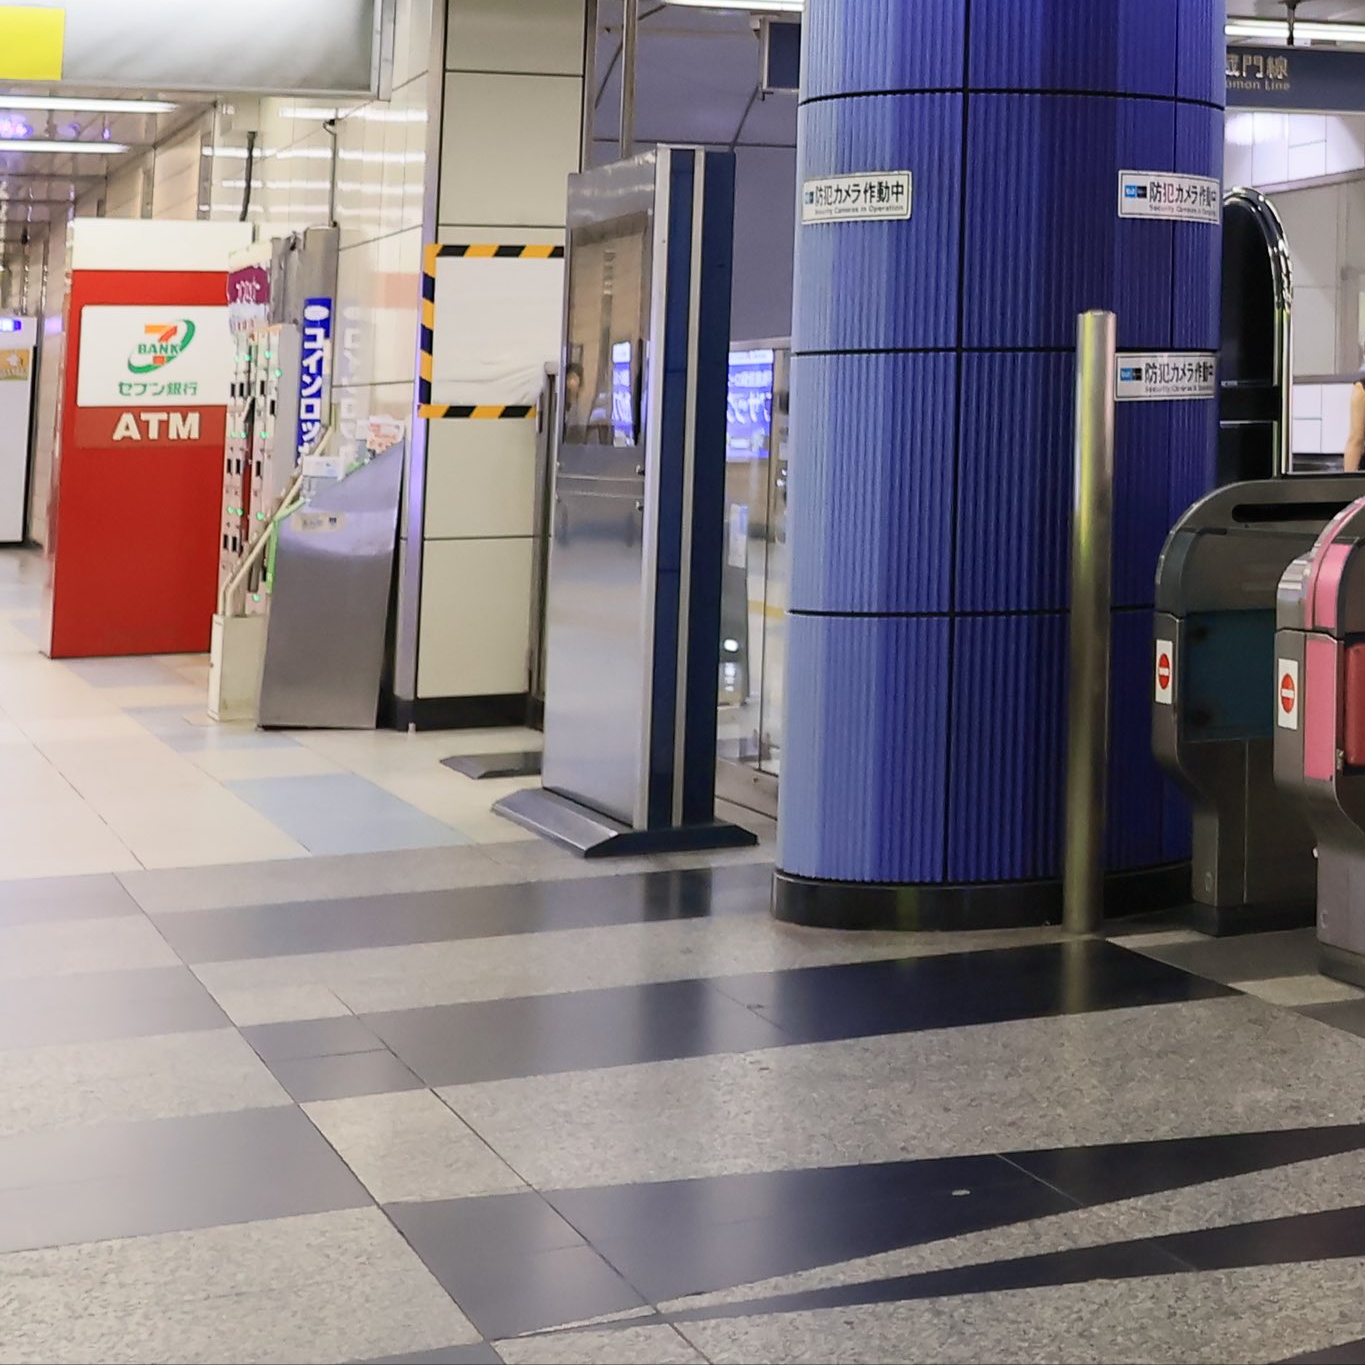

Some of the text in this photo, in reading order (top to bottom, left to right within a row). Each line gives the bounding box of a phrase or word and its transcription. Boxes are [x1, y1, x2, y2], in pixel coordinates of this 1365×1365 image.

[814, 181, 904, 206] 防犯カメラ作動中
[138, 344, 181, 355] BANK
[118, 381, 197, 397] セブン銀行
[113, 412, 200, 441] ATM
